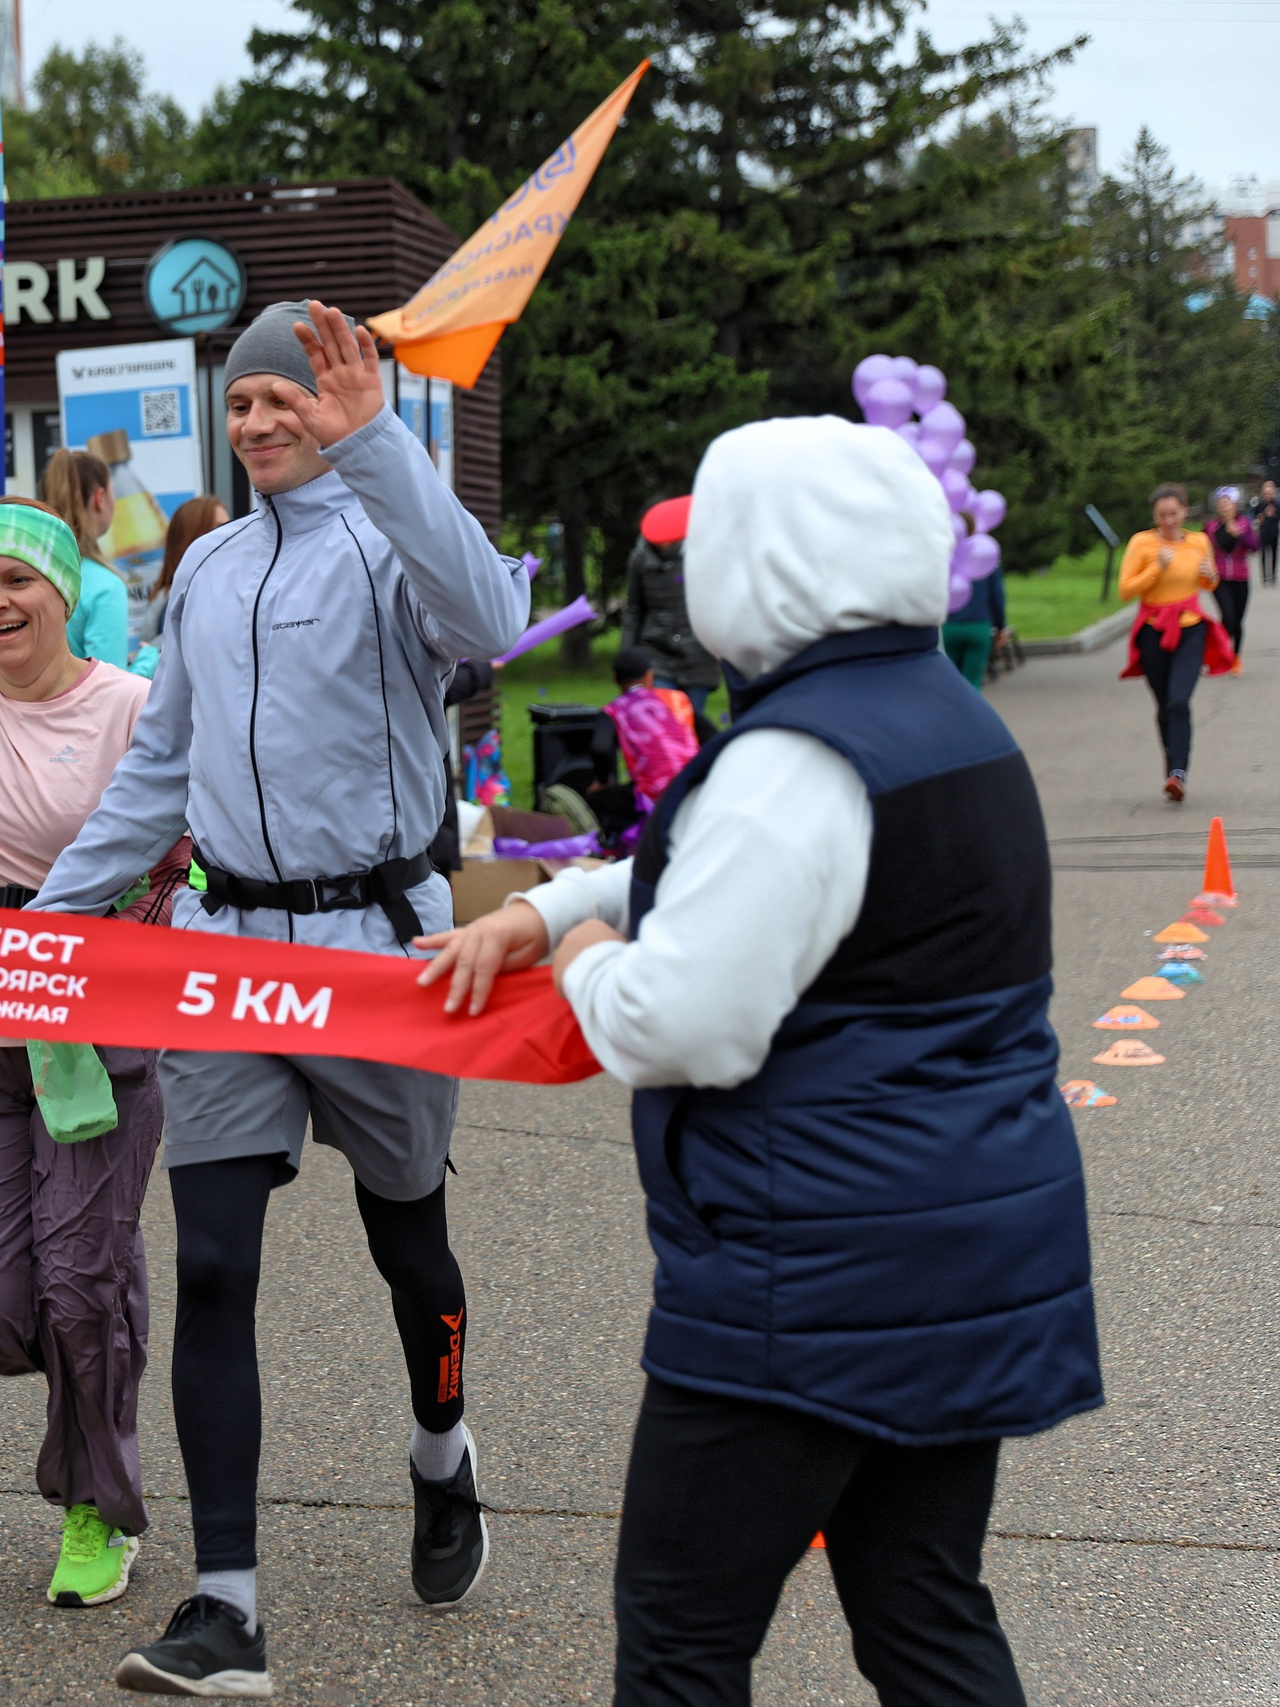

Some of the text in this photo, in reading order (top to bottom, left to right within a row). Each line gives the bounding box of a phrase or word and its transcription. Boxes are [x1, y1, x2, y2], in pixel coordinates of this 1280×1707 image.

[176, 971, 333, 1029] 5 КМ
[448, 1331, 461, 1400] DEMIX
